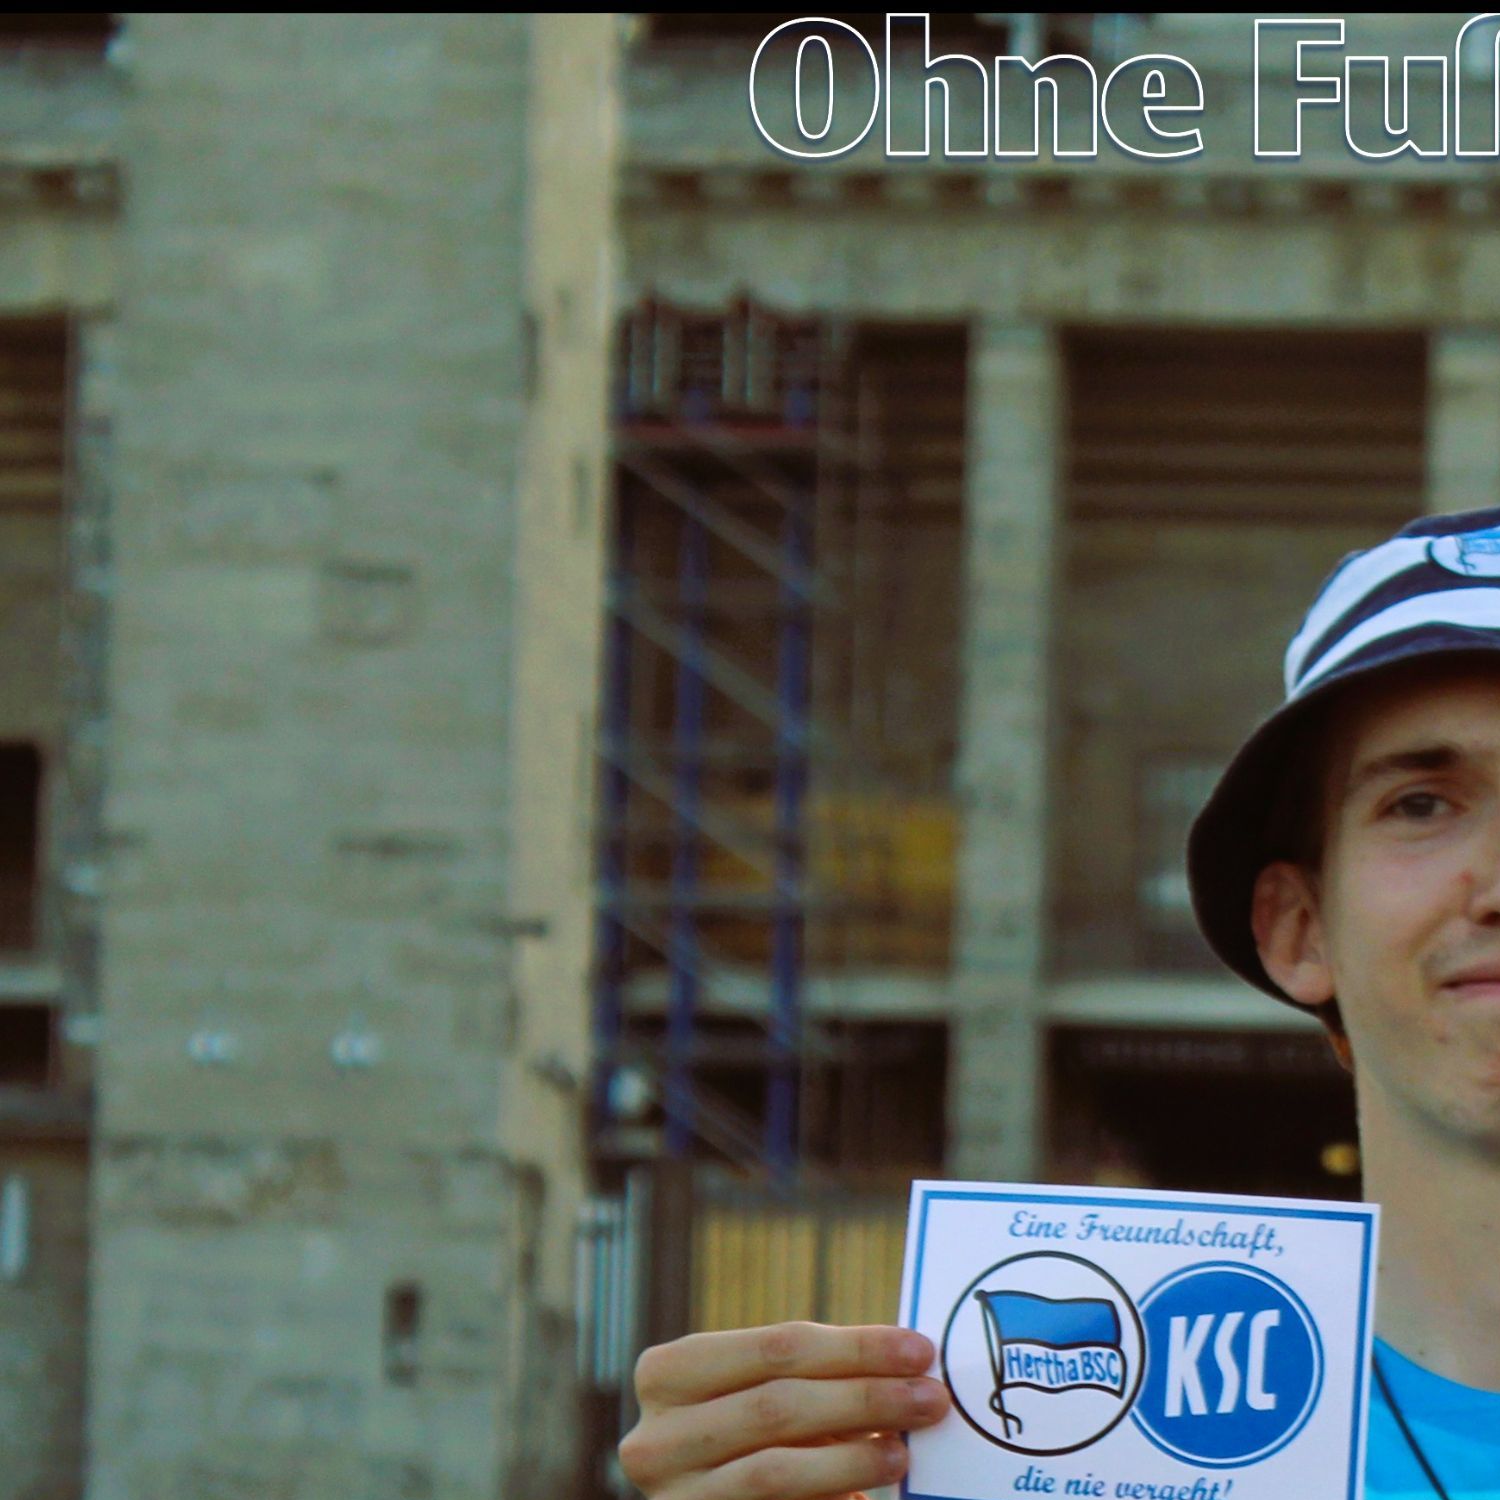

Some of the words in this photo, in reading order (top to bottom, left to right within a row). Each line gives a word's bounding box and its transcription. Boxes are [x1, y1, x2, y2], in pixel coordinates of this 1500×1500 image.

[1008, 1210, 1067, 1239] Eine
[1076, 1213, 1284, 1257] Freundschaft,
[1164, 1309, 1280, 1418] KSC
[1013, 1465, 1056, 1493] die
[1064, 1473, 1105, 1497] nie
